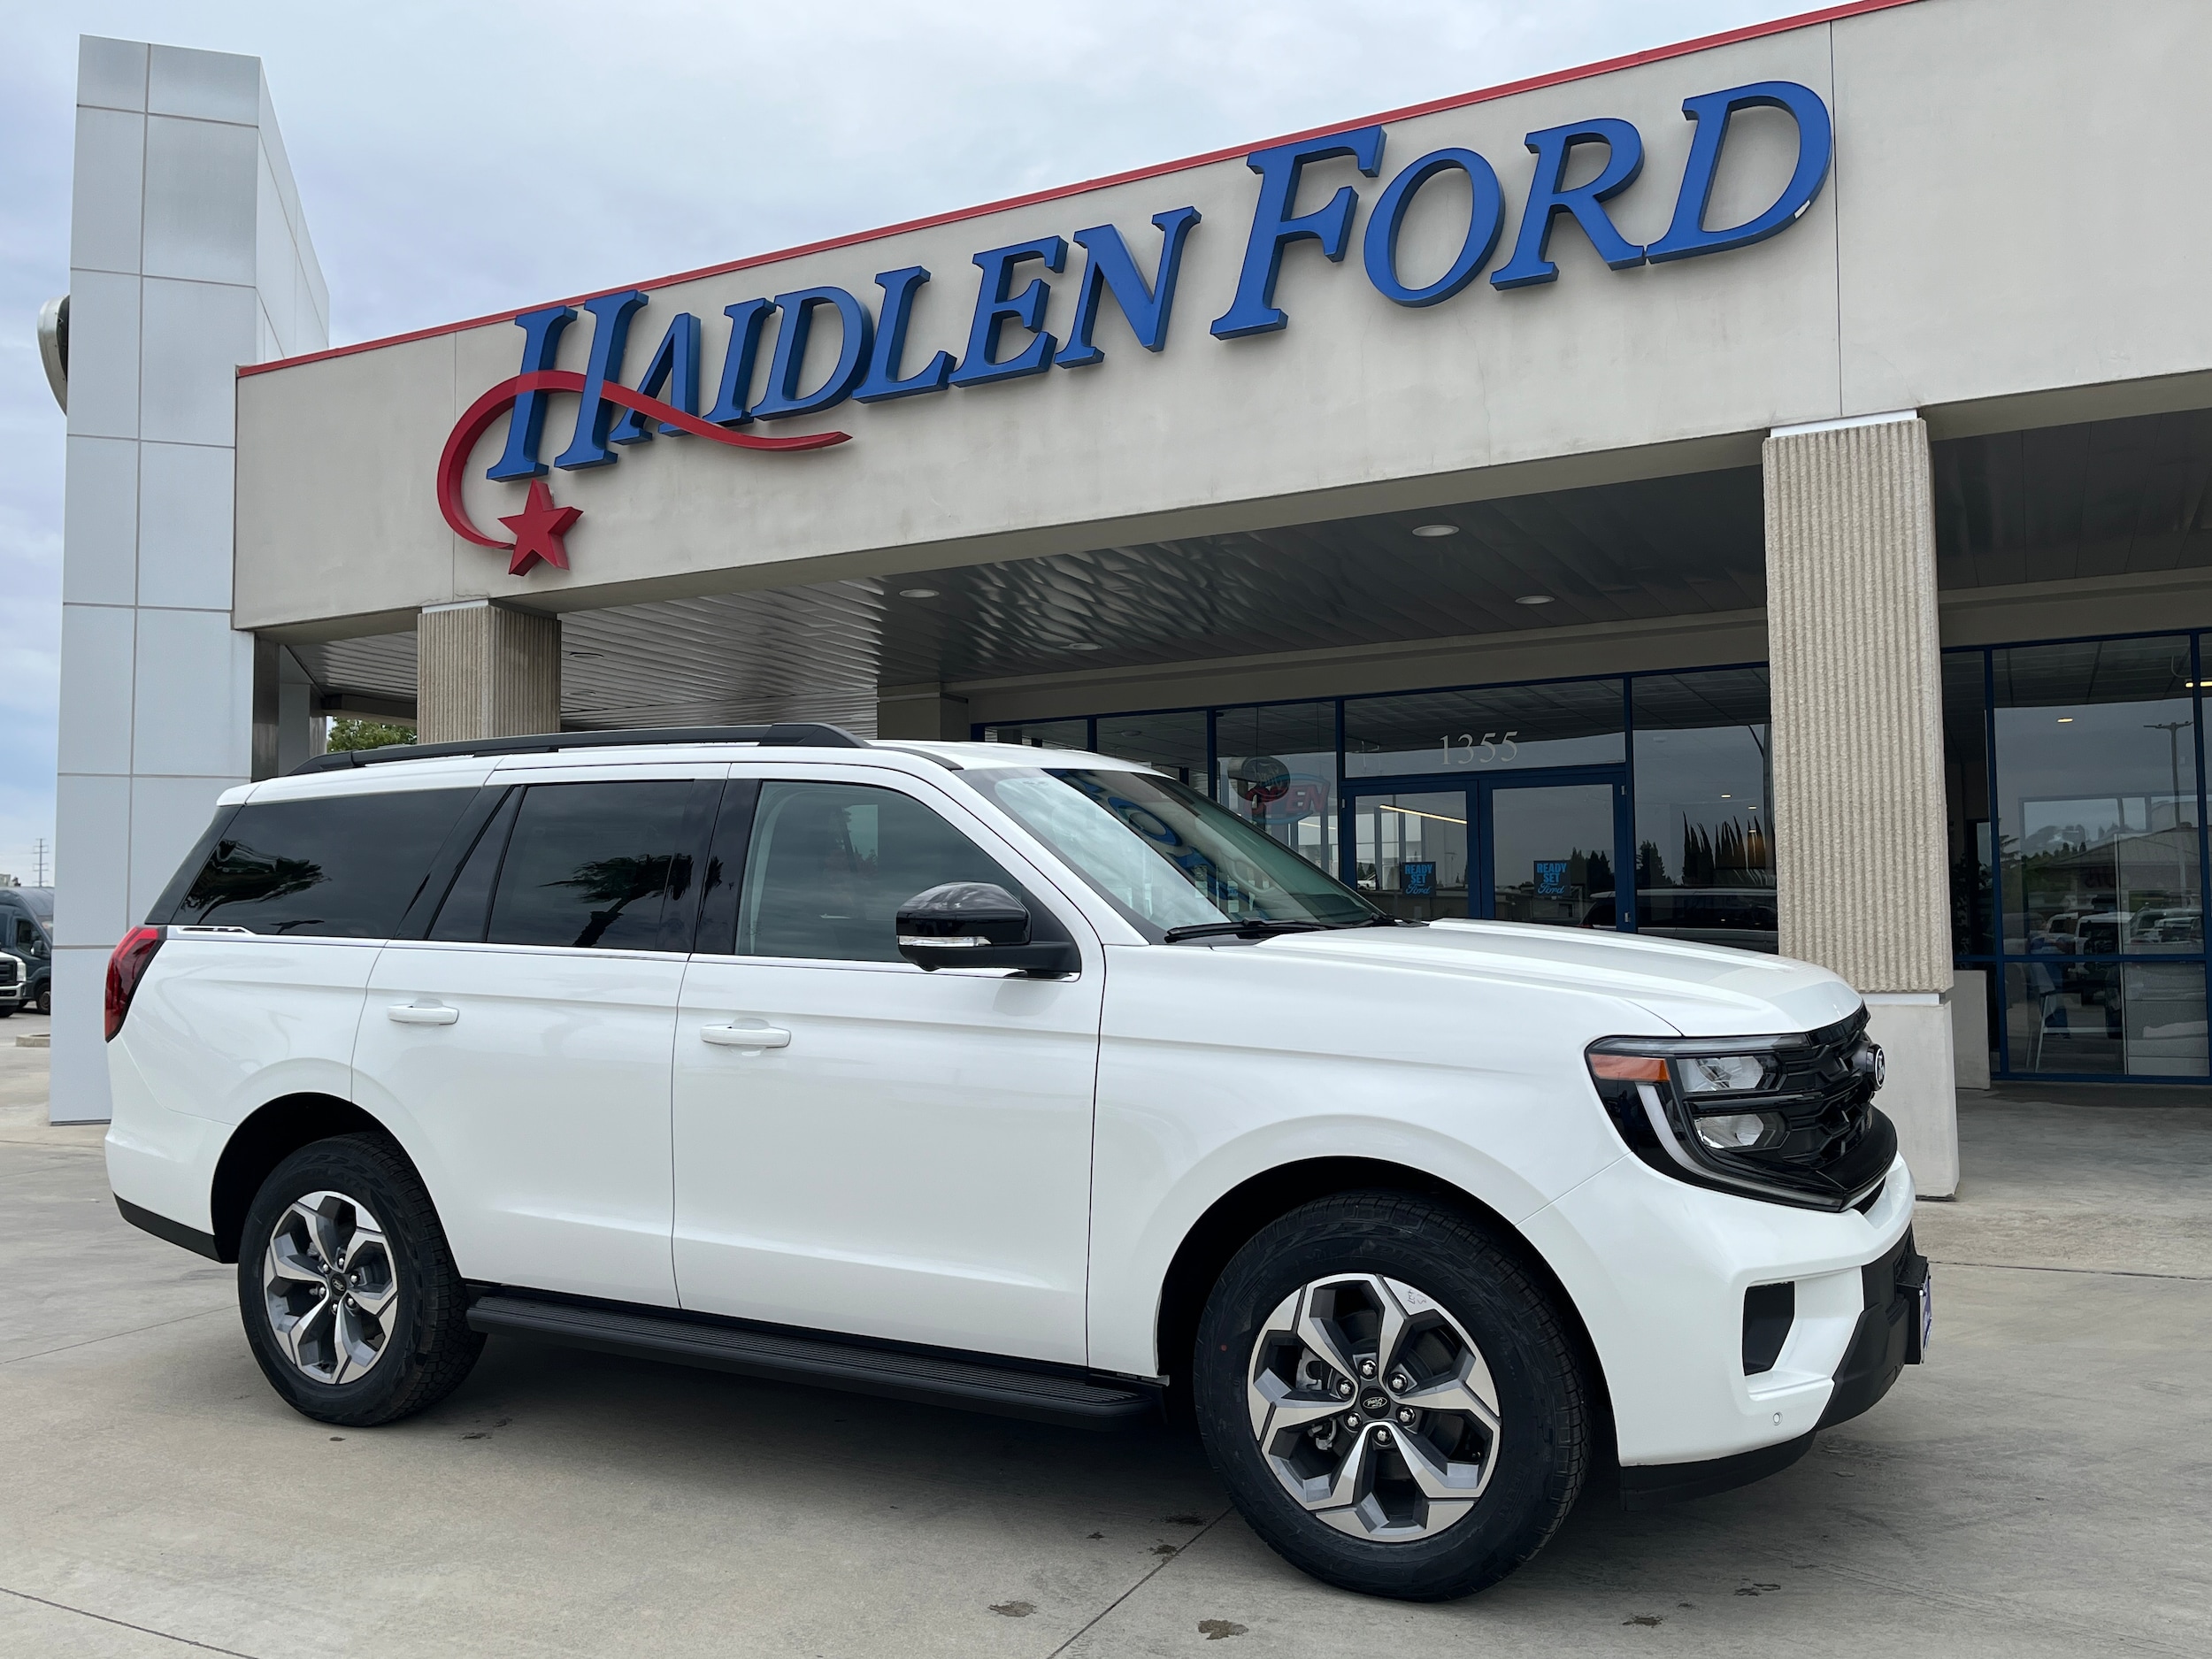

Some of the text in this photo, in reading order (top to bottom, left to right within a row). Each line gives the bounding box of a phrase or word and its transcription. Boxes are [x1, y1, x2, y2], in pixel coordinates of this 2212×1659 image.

[487, 81, 1833, 481] HAIDLEN FORD
[1440, 731, 1518, 765] 1355
[1404, 864, 1432, 874] READY
[1536, 863, 1567, 873] READY
[1410, 874, 1426, 884] SET
[1543, 873, 1560, 883] SET
[1405, 884, 1432, 895] Ford
[1537, 883, 1565, 894] Ford
